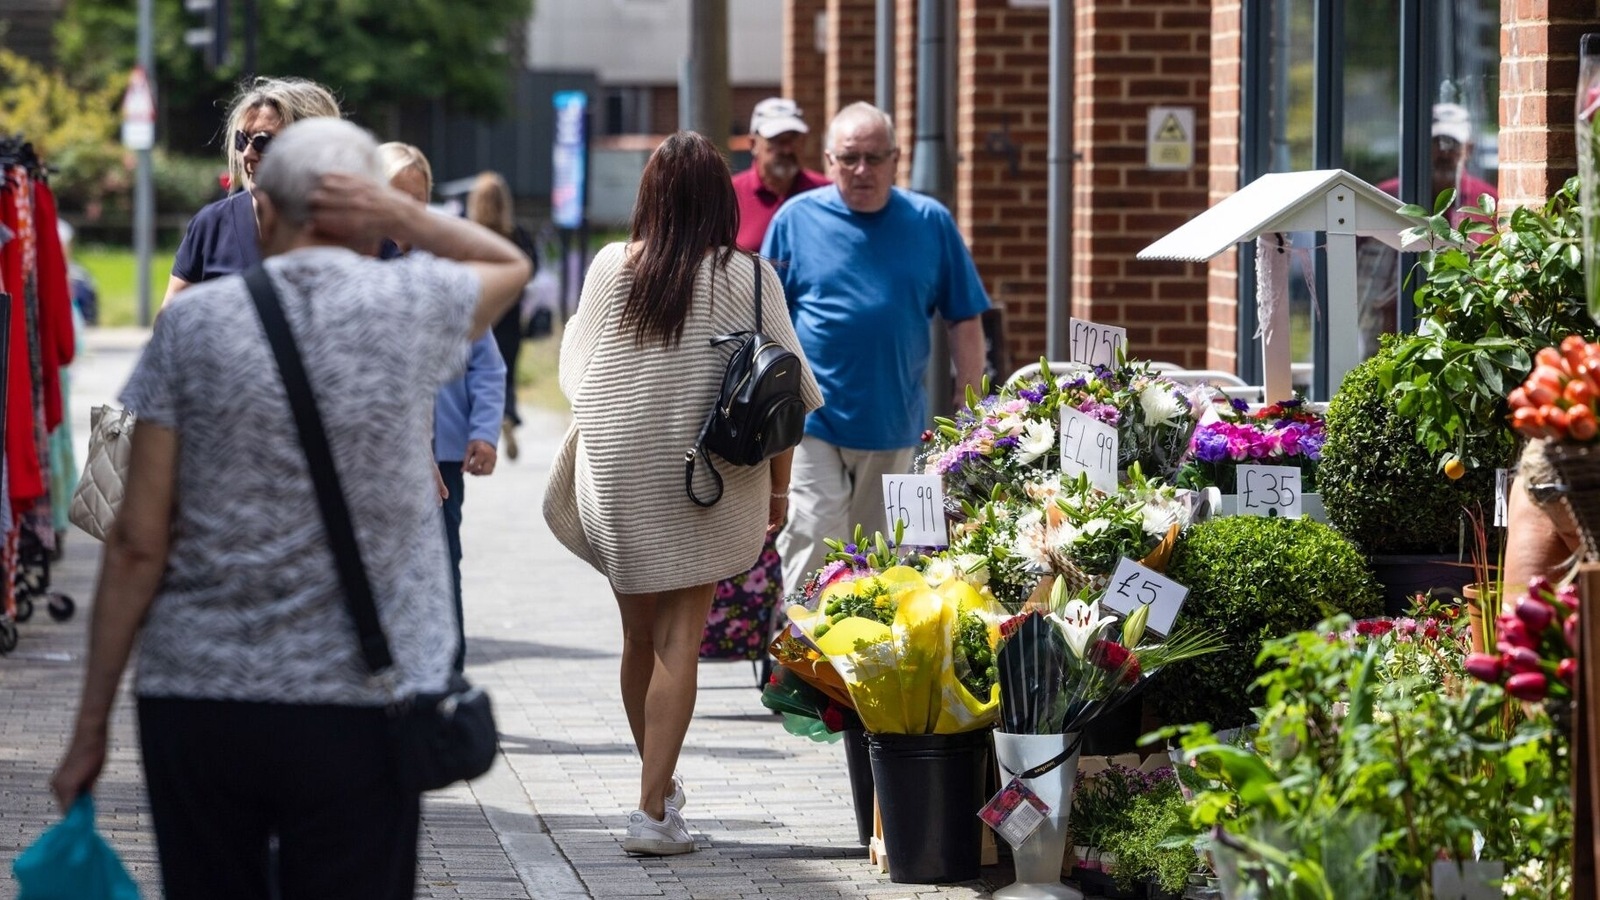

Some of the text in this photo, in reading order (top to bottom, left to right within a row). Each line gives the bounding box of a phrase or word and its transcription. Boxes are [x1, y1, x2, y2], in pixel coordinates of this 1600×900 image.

[1063, 416, 1114, 474] £4.99
[887, 480, 936, 532] £6.99
[1243, 469, 1295, 508] £35
[1117, 572, 1162, 605] £5
